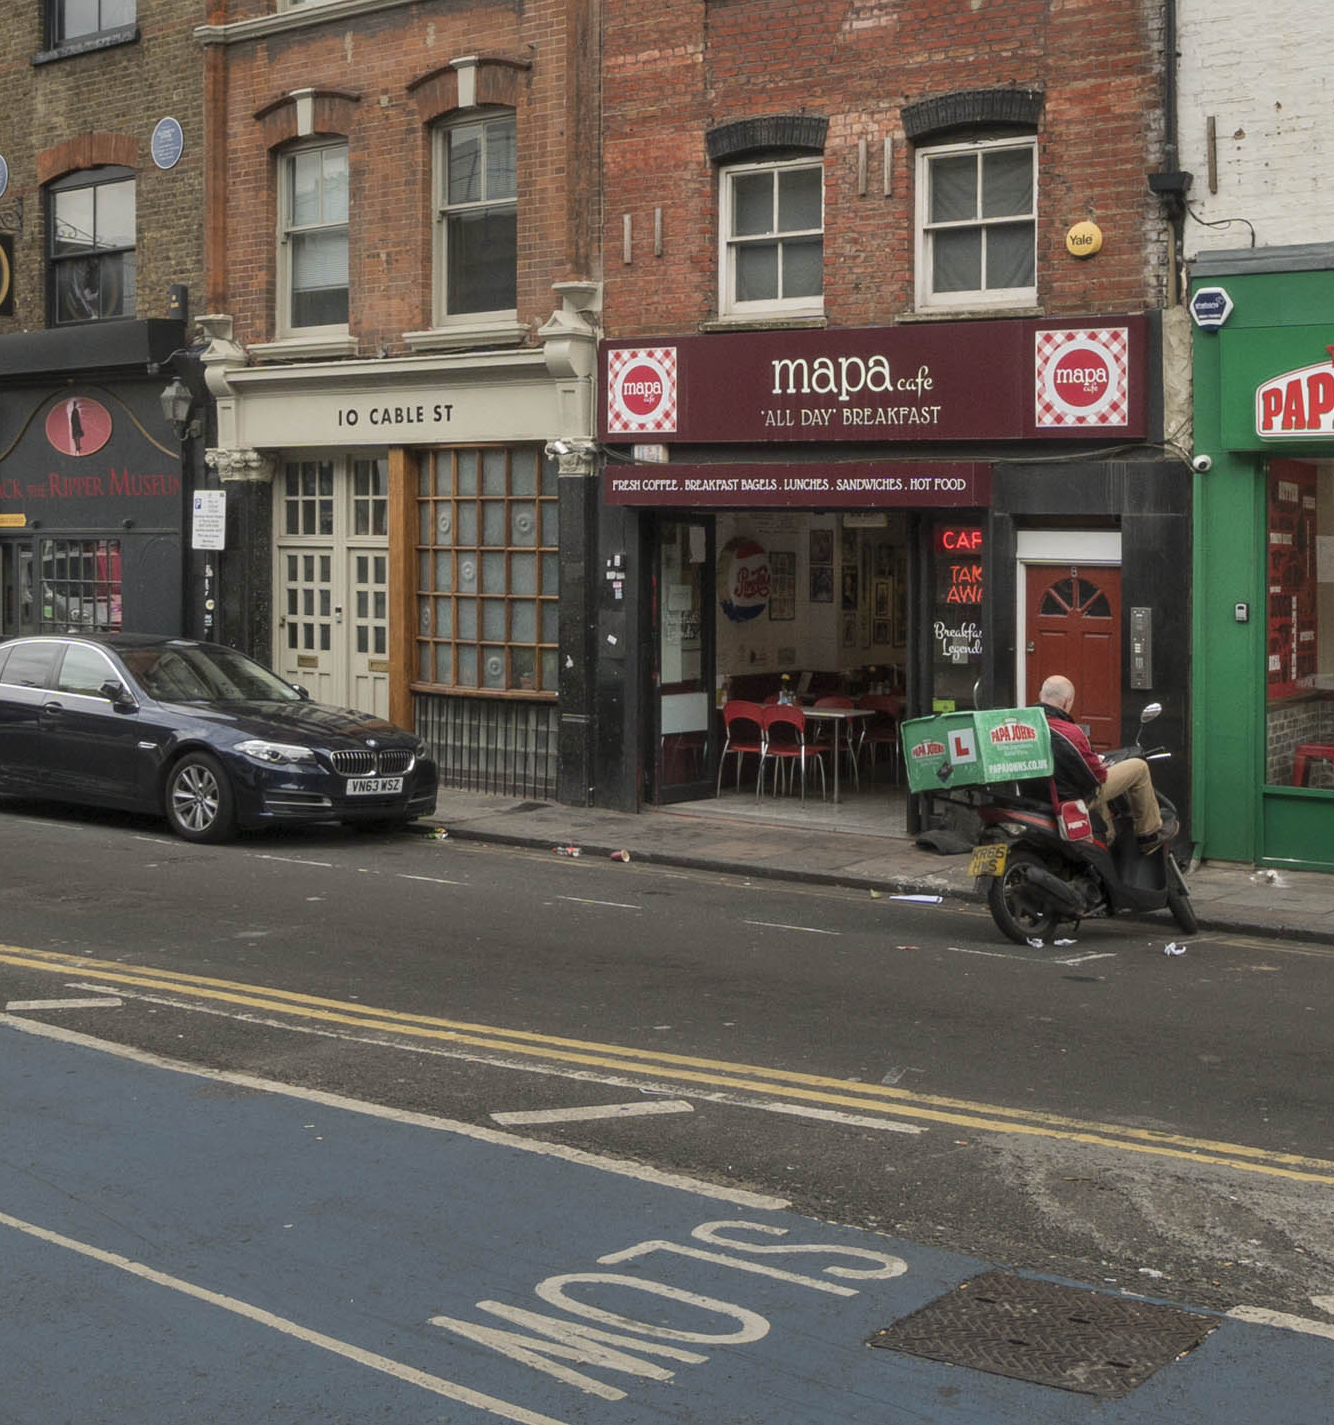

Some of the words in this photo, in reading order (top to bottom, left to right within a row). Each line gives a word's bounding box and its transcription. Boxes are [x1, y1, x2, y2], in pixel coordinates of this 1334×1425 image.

[1069, 234, 1093, 246] Yale
[771, 355, 894, 402] mapa
[896, 365, 934, 400] cafe
[1056, 367, 1108, 386] mapa
[623, 380, 662, 398] mapa
[369, 406, 425, 425] CABLE
[433, 404, 454, 422] ST
[842, 405, 942, 426] BREAKFAST
[612, 479, 641, 491] FRESH
[642, 479, 679, 491] COFFEE
[684, 478, 740, 491] BREAKFAST
[741, 478, 777, 491] BAGELS
[784, 478, 829, 491] LUNCHES
[836, 477, 903, 492] SANDWICHES
[910, 477, 933, 491] HOT
[934, 477, 967, 491] FOOD
[942, 530, 983, 550] CAF
[949, 564, 983, 584] TAK
[942, 637, 983, 661] Legend
[990, 726, 1011, 743] PAPA
[954, 736, 970, 758] L
[352, 779, 379, 792] VN63
[427, 1219, 909, 1402] SLOW
